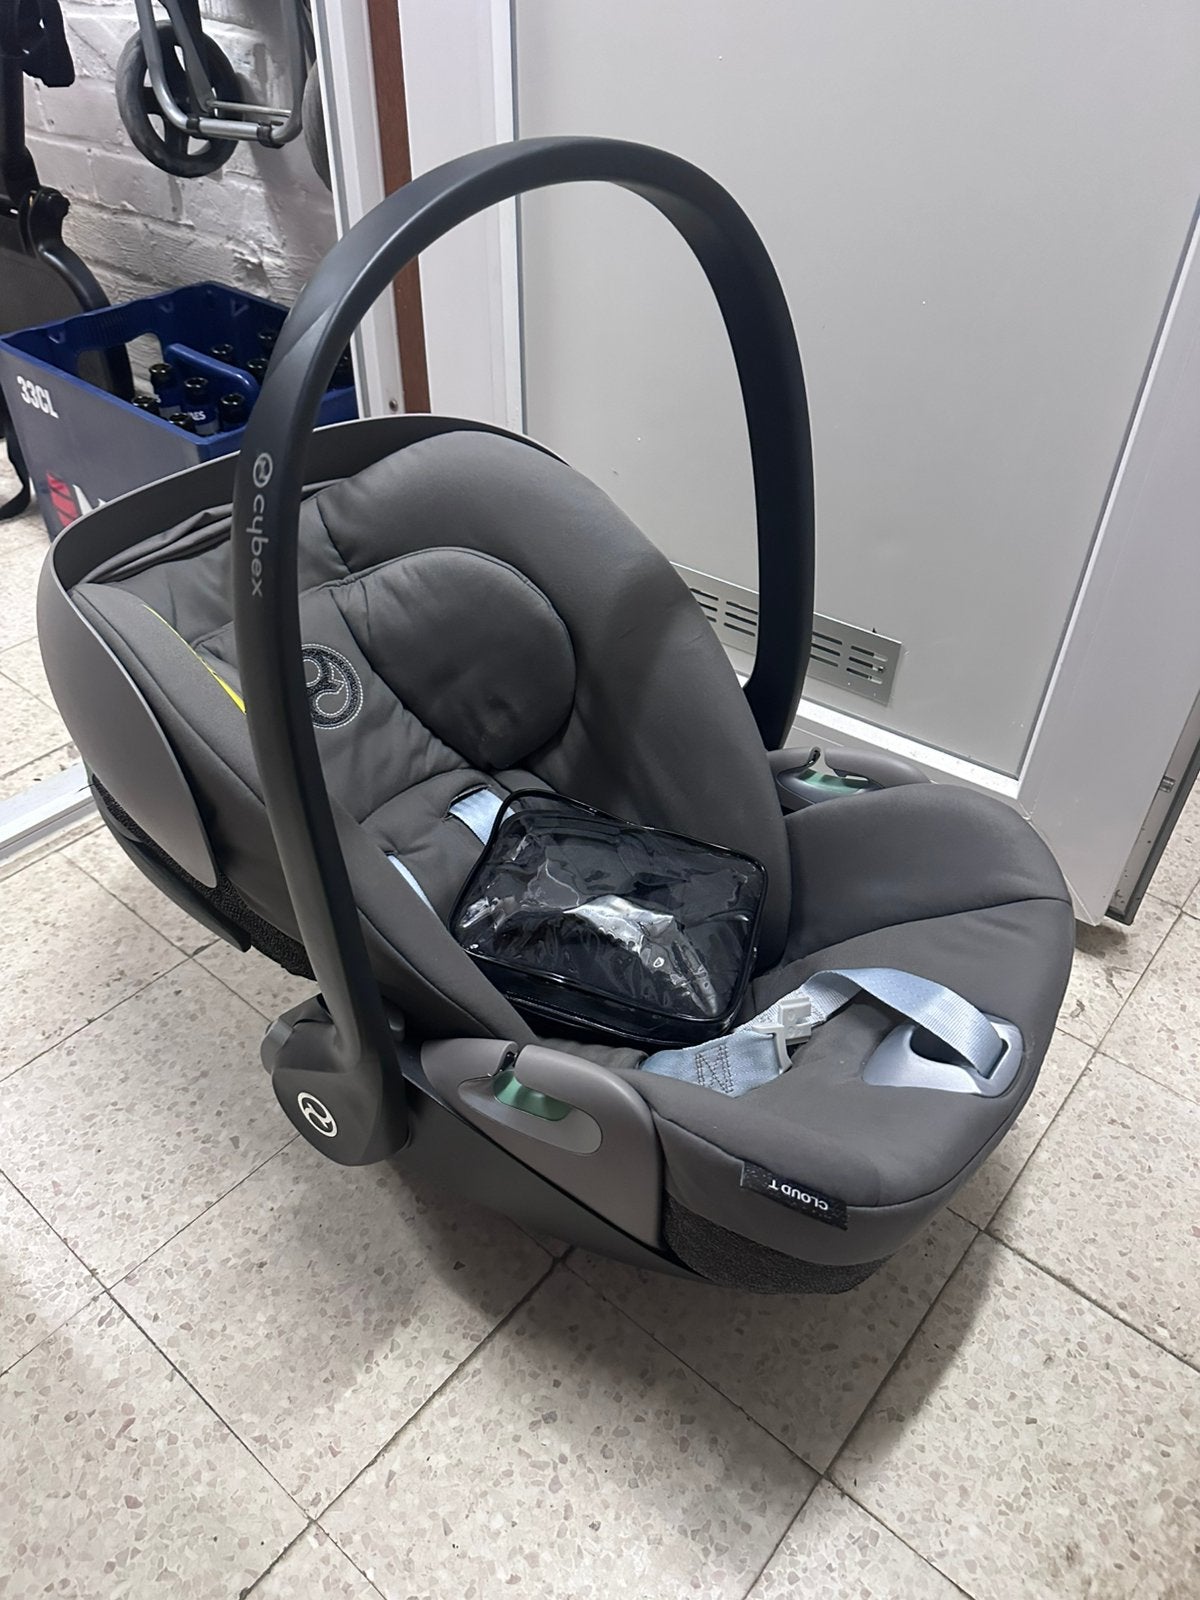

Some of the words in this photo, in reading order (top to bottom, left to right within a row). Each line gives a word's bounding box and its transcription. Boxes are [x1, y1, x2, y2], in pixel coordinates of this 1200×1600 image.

[16, 375, 59, 419] 33CL
[246, 494, 269, 597] cybex
[768, 1179, 779, 1191] T
[780, 1184, 829, 1211] CLOUD
